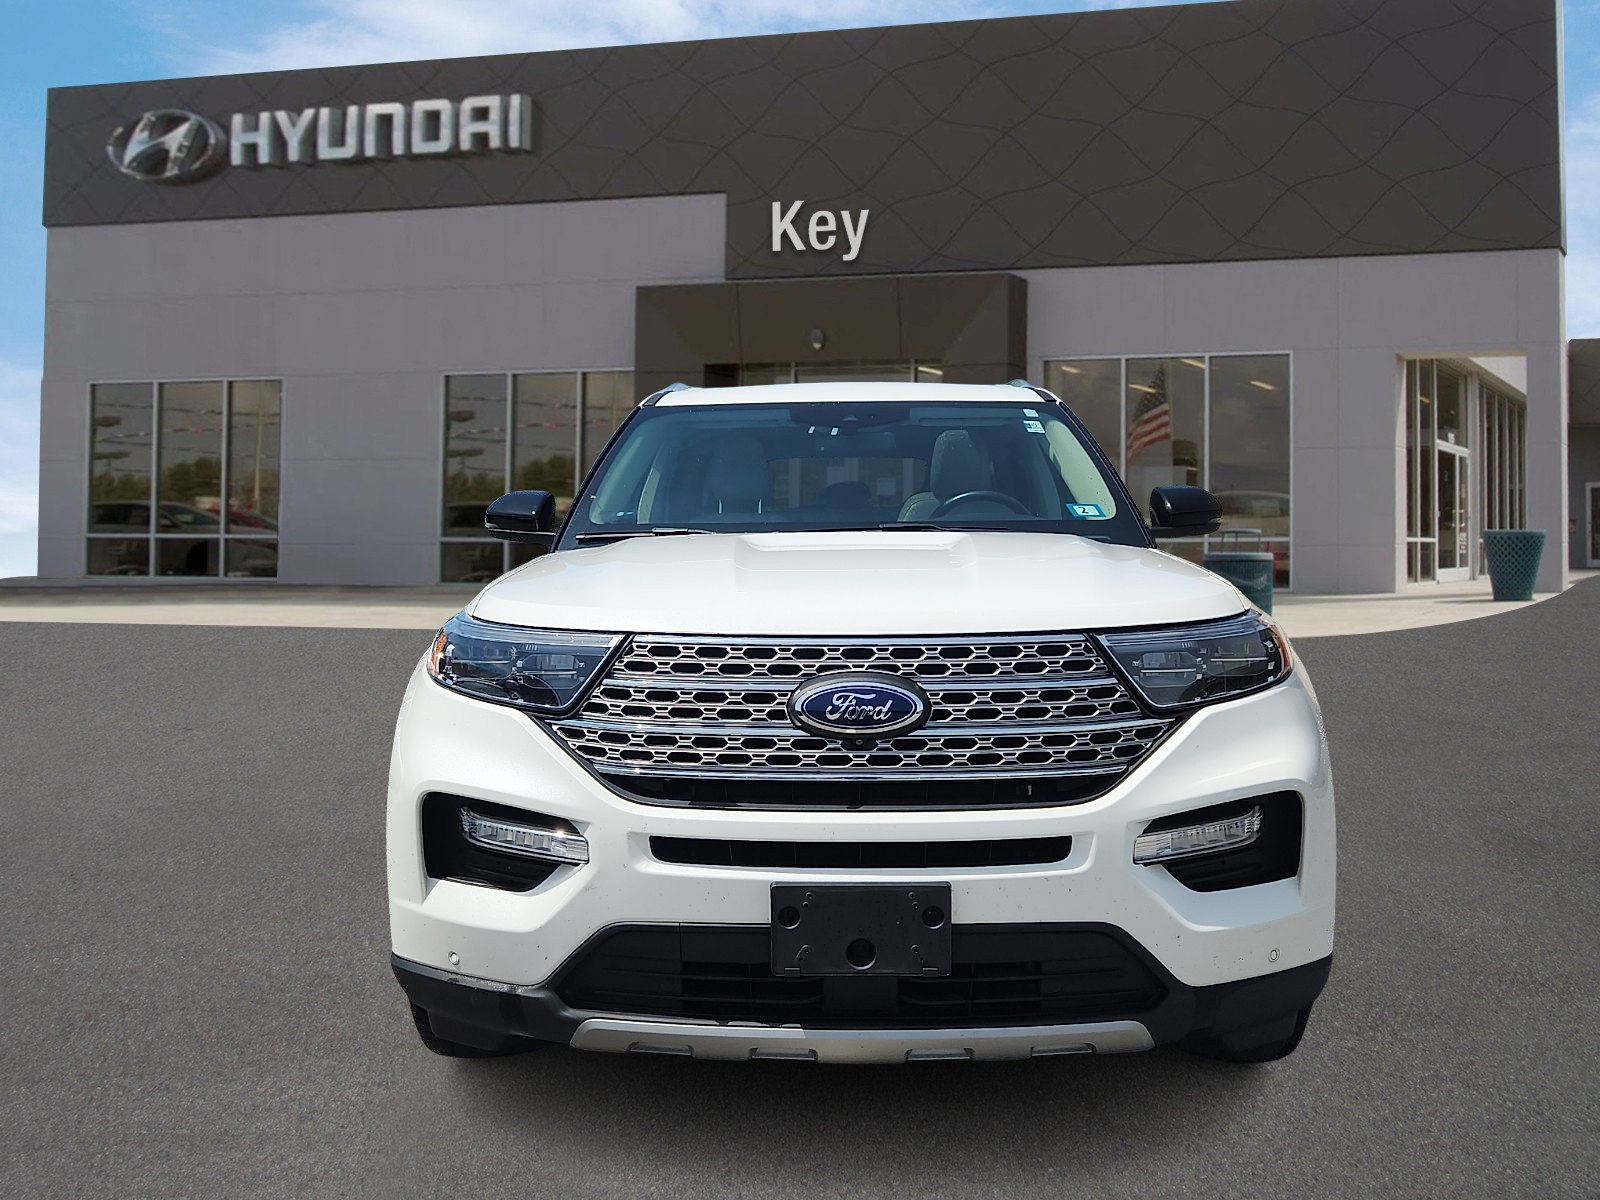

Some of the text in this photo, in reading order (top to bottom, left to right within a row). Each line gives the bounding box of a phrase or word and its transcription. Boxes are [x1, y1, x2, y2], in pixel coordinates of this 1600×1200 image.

[229, 93, 531, 167] HYUNDAI
[771, 200, 870, 262] Key
[825, 692, 893, 721] Ford
